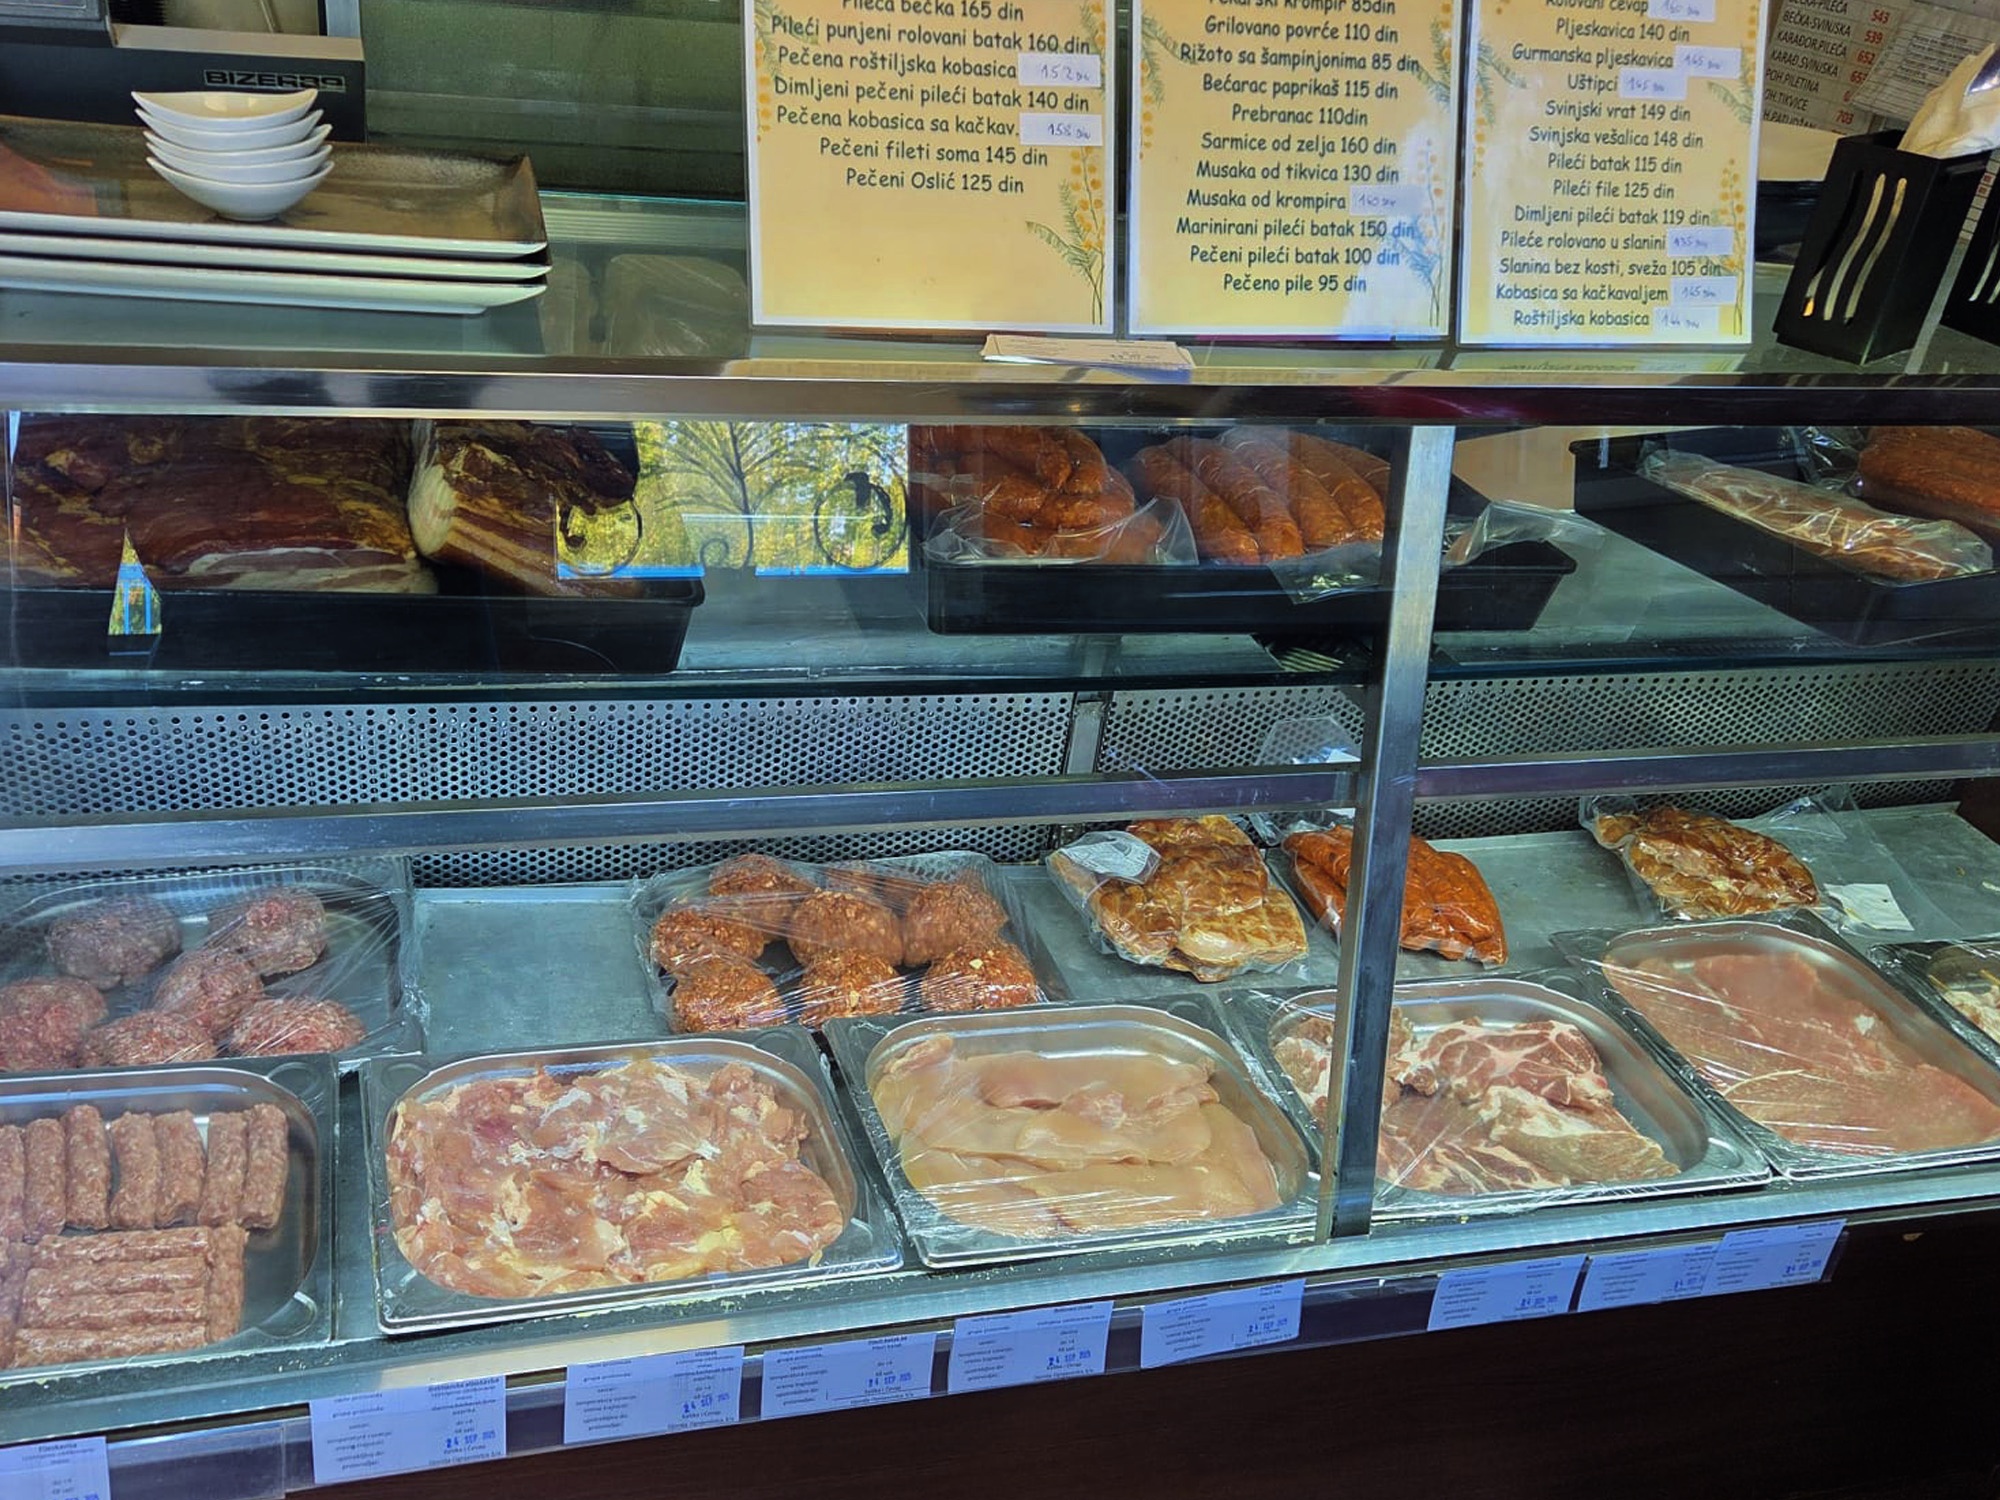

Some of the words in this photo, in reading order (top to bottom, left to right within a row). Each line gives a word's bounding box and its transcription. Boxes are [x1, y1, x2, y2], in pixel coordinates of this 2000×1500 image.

[961, 2, 992, 20] 165
[998, 3, 1024, 21] din
[771, 15, 820, 36] Pileći
[827, 21, 891, 45] punjeni
[898, 24, 966, 46] rolovani
[973, 27, 1022, 50] batak
[1028, 34, 1058, 52] 160
[1064, 36, 1090, 55] din
[1205, 15, 1280, 37] Grilovano
[1285, 21, 1340, 42] povrće
[1345, 24, 1370, 40] 110
[1375, 25, 1398, 43] din
[1556, 18, 1635, 40] Pljeskavica
[1639, 24, 1665, 40] 140
[1669, 26, 1690, 42] din
[779, 46, 843, 68] Pečena
[850, 52, 936, 76] roštiljska
[942, 56, 1017, 79] kobasica
[1180, 43, 1233, 63] Rižoto
[1238, 51, 1256, 65] sa
[1261, 47, 1366, 72] šampinjonima
[1371, 55, 1392, 70] 85
[1397, 55, 1420, 73] din
[1512, 43, 1591, 64] Gurmanska
[1596, 47, 1673, 70] pljeskavica
[774, 76, 849, 101] Dimljeni
[856, 82, 915, 107] pečeni
[920, 84, 966, 107] pileći
[973, 87, 1021, 109] batak
[1028, 91, 1058, 109] 140
[1064, 93, 1089, 111] din
[1203, 73, 1267, 95] Bećarac
[1272, 77, 1339, 99] paprikaš
[1345, 82, 1370, 98] 115
[1375, 83, 1398, 100] din
[1567, 73, 1618, 92] Uštipci
[777, 105, 842, 127] Pečena
[848, 110, 924, 132] kobasica
[930, 119, 950, 133] sa
[1232, 103, 1313, 124] Prebranac
[1319, 108, 1368, 126] 110din
[1545, 100, 1602, 123] Svinjski
[1607, 104, 1636, 119] vrat
[1641, 106, 1665, 121] 149
[1669, 106, 1690, 122] din
[1201, 132, 1267, 151] Sarmice
[1272, 135, 1291, 151] od
[1296, 136, 1336, 157] zelja
[1341, 138, 1368, 154] 160
[1374, 138, 1397, 155] din
[1529, 126, 1590, 149] Svinjska
[1595, 128, 1649, 147] vešalica
[1653, 131, 1678, 147] 148
[1682, 132, 1703, 149] din
[820, 137, 879, 158] Pečeni
[886, 140, 930, 161] fileti
[936, 148, 980, 163] soma
[986, 146, 1016, 164] 145
[1022, 147, 1048, 166] din
[1548, 153, 1585, 171] Pileći
[1590, 155, 1630, 172] batak
[1634, 156, 1656, 173] 115
[1661, 156, 1682, 173] din
[846, 168, 905, 188] Pečeni
[911, 170, 956, 191] Oslić
[962, 174, 992, 192] 125
[998, 175, 1024, 193] din
[1196, 161, 1257, 180] Musaka
[1261, 163, 1280, 180] od
[1286, 164, 1338, 182] tikvica
[1343, 166, 1371, 182] 130
[1376, 165, 1399, 183] din
[1553, 179, 1590, 197] Pileći
[1596, 180, 1620, 198] file
[1624, 183, 1649, 199] 125
[1653, 183, 1675, 199] din
[1187, 189, 1247, 208] Musaka
[1252, 191, 1271, 208] od
[1276, 191, 1346, 213] krompira
[1514, 205, 1572, 226] Dimljeni
[1577, 206, 1615, 228] pileći
[1618, 207, 1659, 224] batak
[1662, 209, 1684, 225] 119
[1689, 209, 1710, 226] din
[1176, 217, 1258, 236] Marinirani
[1264, 218, 1305, 243] pileći
[1311, 219, 1355, 238] batak
[1360, 221, 1387, 238] 150
[1392, 221, 1414, 238] din
[1500, 230, 1543, 248] Pileće
[1547, 234, 1606, 250] rolovano
[1610, 238, 1619, 249] u
[1622, 234, 1666, 251] slanini
[1190, 245, 1243, 264] Pečeni
[1248, 246, 1289, 267] pileći
[1295, 247, 1340, 265] batak
[1345, 248, 1371, 265] 100
[1377, 249, 1400, 266] din
[1499, 258, 1550, 275] Slanina
[1554, 259, 1579, 275] bez
[1584, 259, 1624, 277] kosti,
[1628, 259, 1667, 276] sveža
[1671, 260, 1695, 276] 105
[1700, 259, 1722, 277] din
[1224, 273, 1280, 292] Pečeno
[1285, 275, 1313, 295] pile
[1318, 275, 1339, 291] 95
[1344, 276, 1367, 292] din
[1496, 283, 1558, 300] Kobasica
[1562, 287, 1578, 299] sa
[1582, 283, 1668, 304] kačkavaljem
[1514, 309, 1585, 328] Roštiljska
[1589, 309, 1650, 327] kobasica
